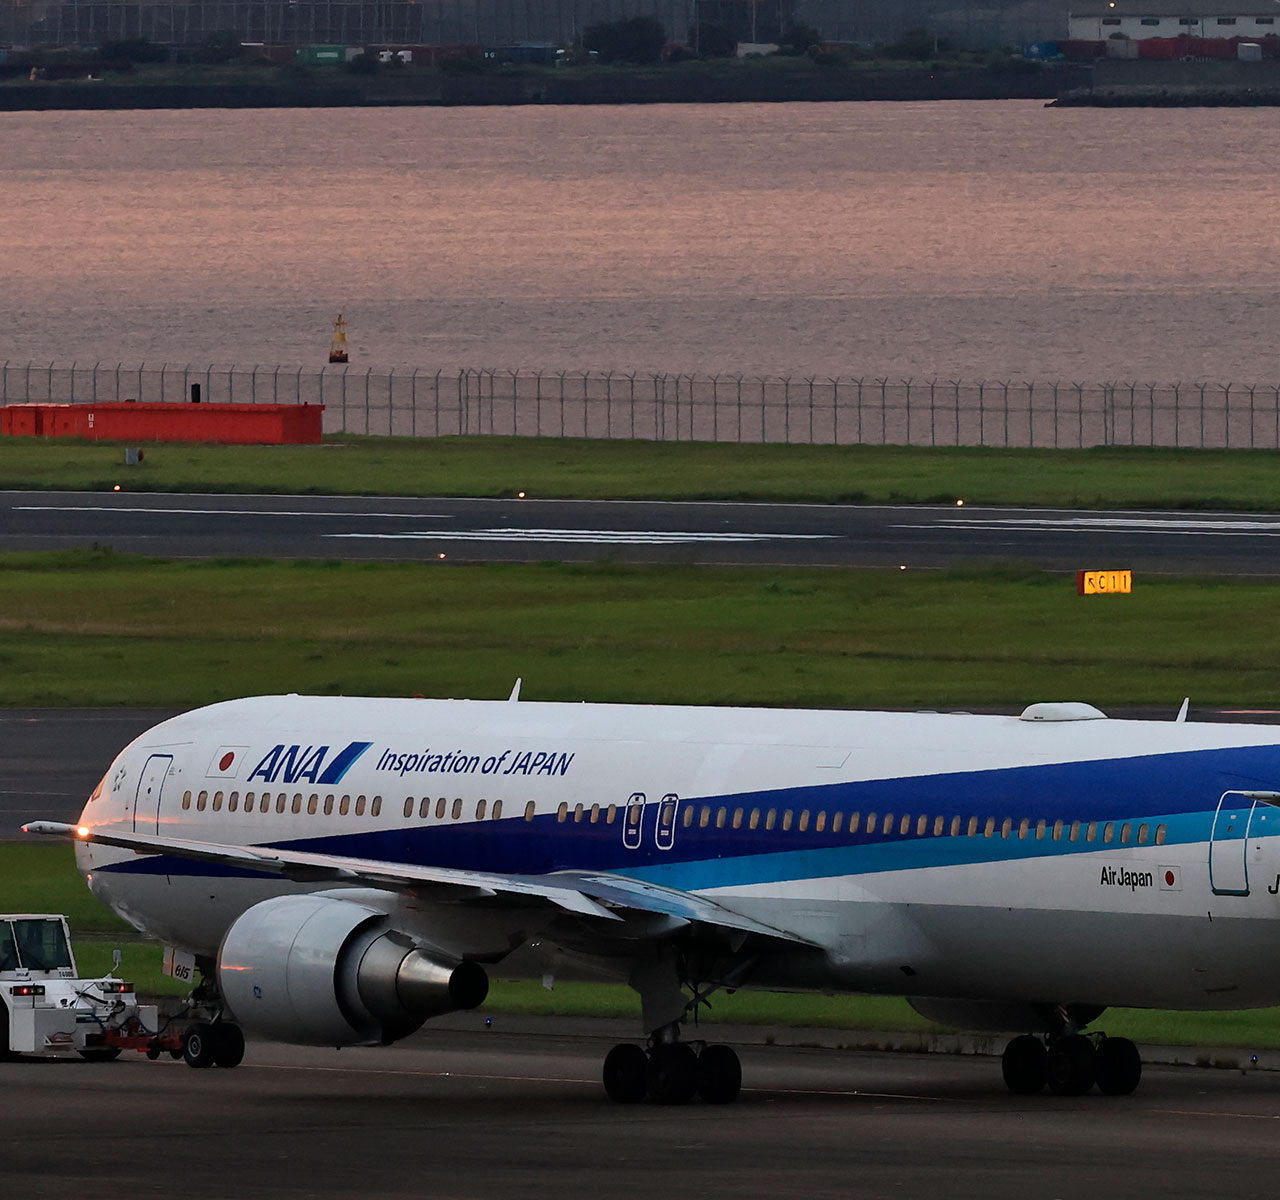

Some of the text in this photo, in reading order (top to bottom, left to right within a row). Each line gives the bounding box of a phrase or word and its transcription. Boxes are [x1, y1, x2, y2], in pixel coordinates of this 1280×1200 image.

[247, 744, 330, 784] ANA
[376, 747, 575, 776] Inspiration of JAPAN
[1100, 866, 1153, 892] Air Japan
